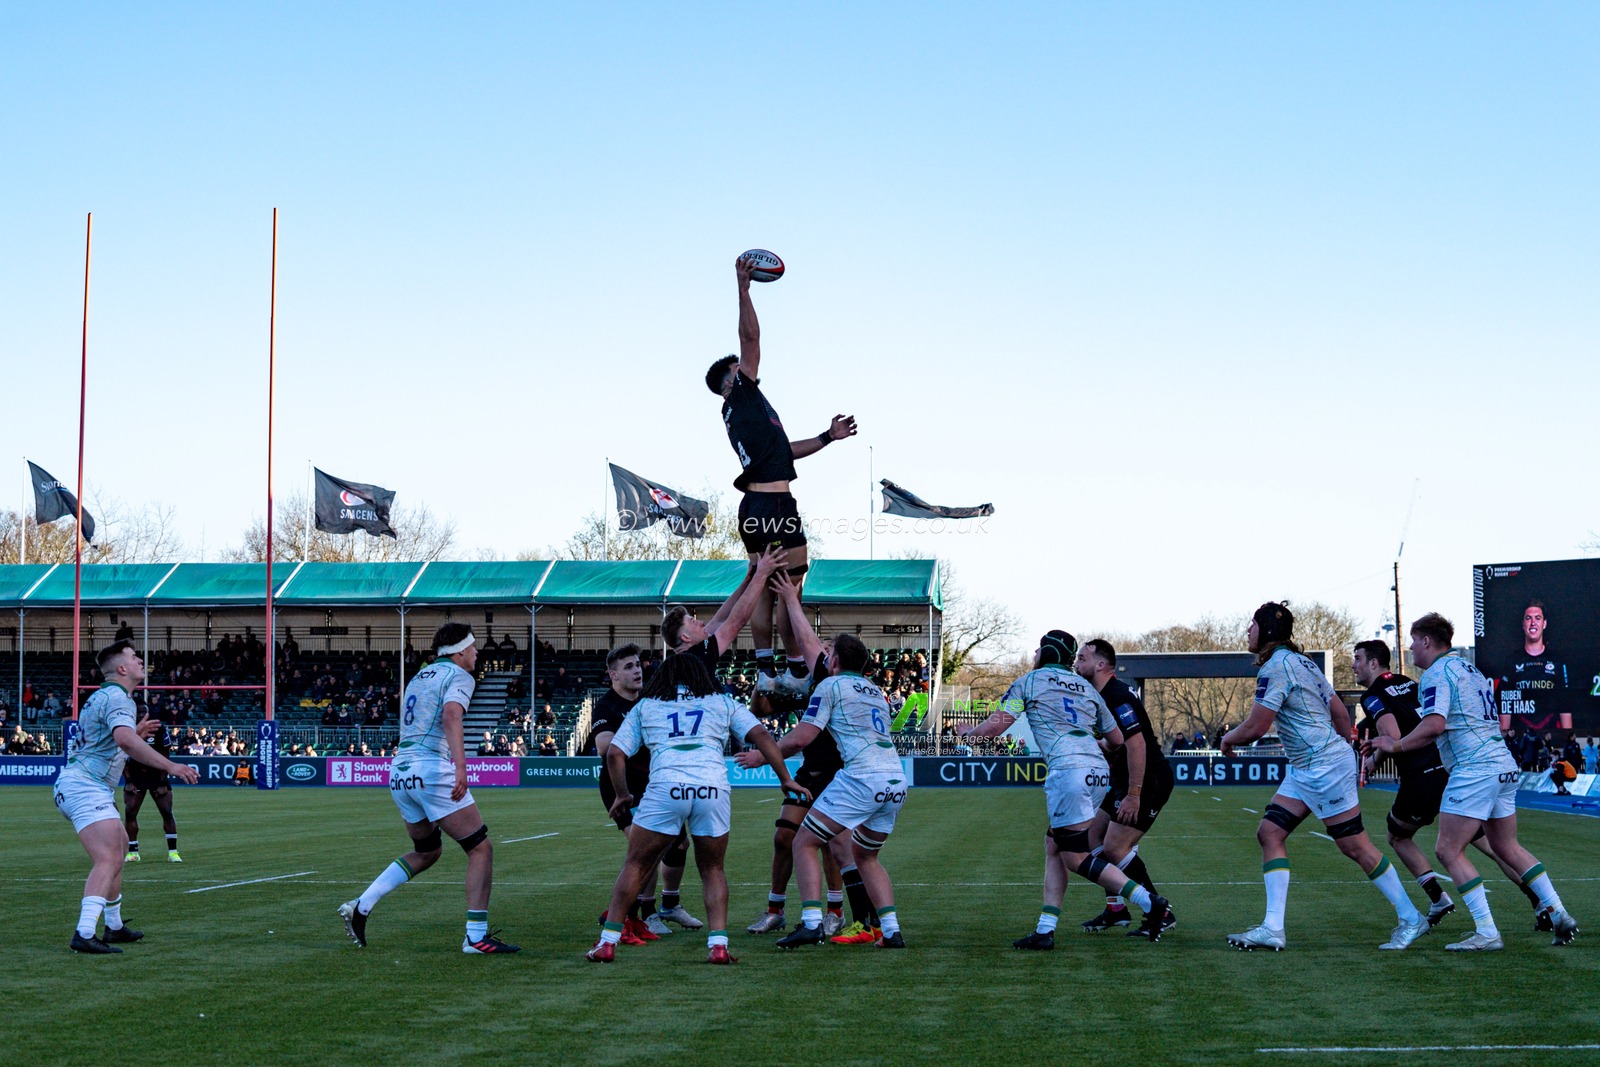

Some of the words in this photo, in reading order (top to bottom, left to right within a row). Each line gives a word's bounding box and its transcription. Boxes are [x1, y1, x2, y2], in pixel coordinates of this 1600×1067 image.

[1474, 568, 1485, 637] SUBSTITUTION
[1501, 690, 1521, 700] RUBEN
[404, 695, 417, 726] 8
[1062, 697, 1077, 724] 5
[1501, 701, 1513, 714] DE
[1514, 700, 1535, 714] HAAS
[667, 710, 704, 738] 17
[871, 708, 885, 734] 6
[354, 773, 383, 782] Bank
[526, 768, 564, 777] GREENE
[565, 768, 590, 777] KING
[940, 762, 997, 782] CITY
[1006, 762, 1048, 782] IND
[1176, 763, 1290, 781] CASTOR
[390, 773, 424, 791] cinch
